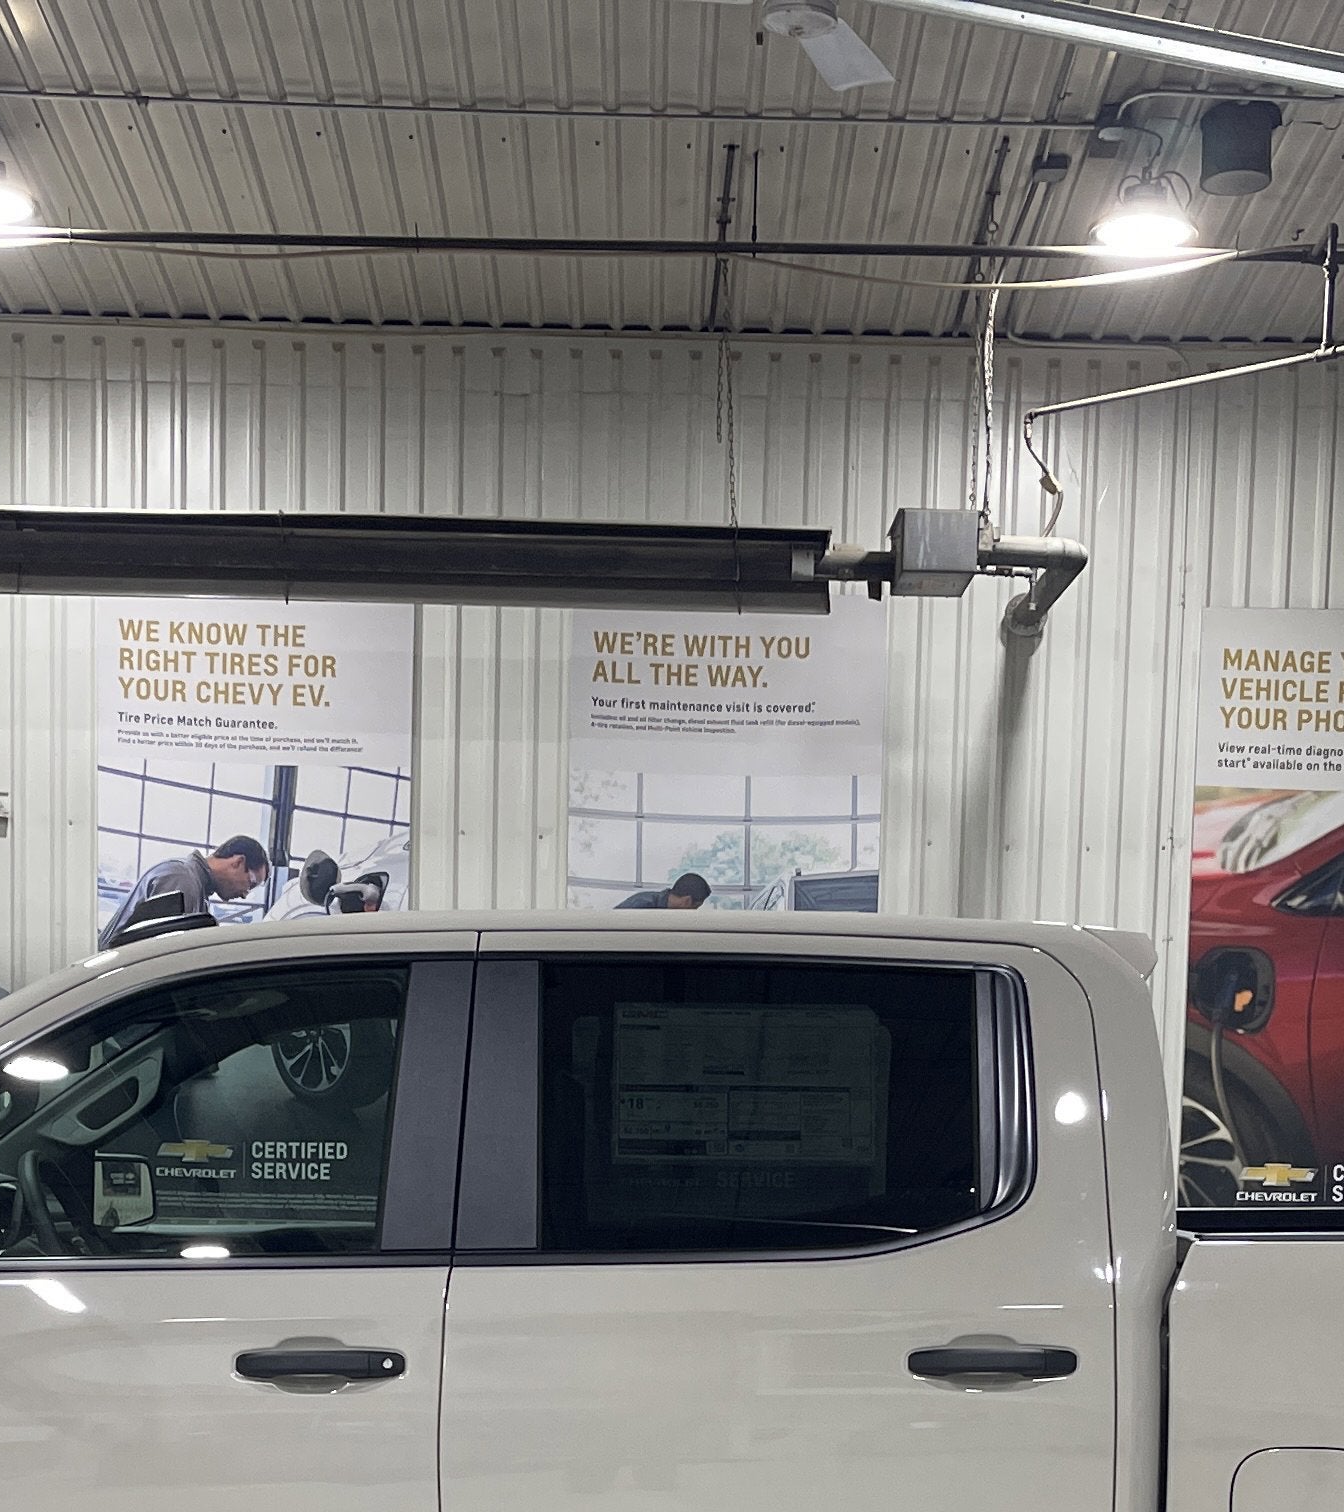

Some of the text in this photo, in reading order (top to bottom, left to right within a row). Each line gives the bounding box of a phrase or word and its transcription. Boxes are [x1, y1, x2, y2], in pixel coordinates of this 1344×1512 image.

[119, 618, 306, 648] WE KNOW THE
[593, 631, 811, 659] WE'RE WITH YOU
[119, 648, 337, 678] RIGHT TIRES FOR
[1222, 648, 1332, 674] MANAGE
[592, 660, 768, 688] ALL THE WAY.
[118, 677, 331, 707] YOUR CHEVY EV.
[1221, 678, 1330, 703] VEHICLE
[591, 696, 617, 708] Your
[620, 698, 646, 710] first
[649, 700, 723, 712] maintenance
[725, 701, 750, 712] visit
[753, 702, 763, 713] is
[117, 711, 278, 729] Tire Price Match Guarantee.
[1220, 706, 1287, 730] YOUR
[1218, 742, 1245, 754] View
[1248, 744, 1302, 756] real-time
[1253, 759, 1303, 770] available
[1306, 762, 1320, 771] on
[1323, 761, 1342, 772] the
[251, 1141, 347, 1160] CERTIFIED
[156, 1167, 236, 1179] CHEVROLET
[251, 1162, 330, 1180] SERVICE
[1236, 1191, 1318, 1202] CHEVROLET
